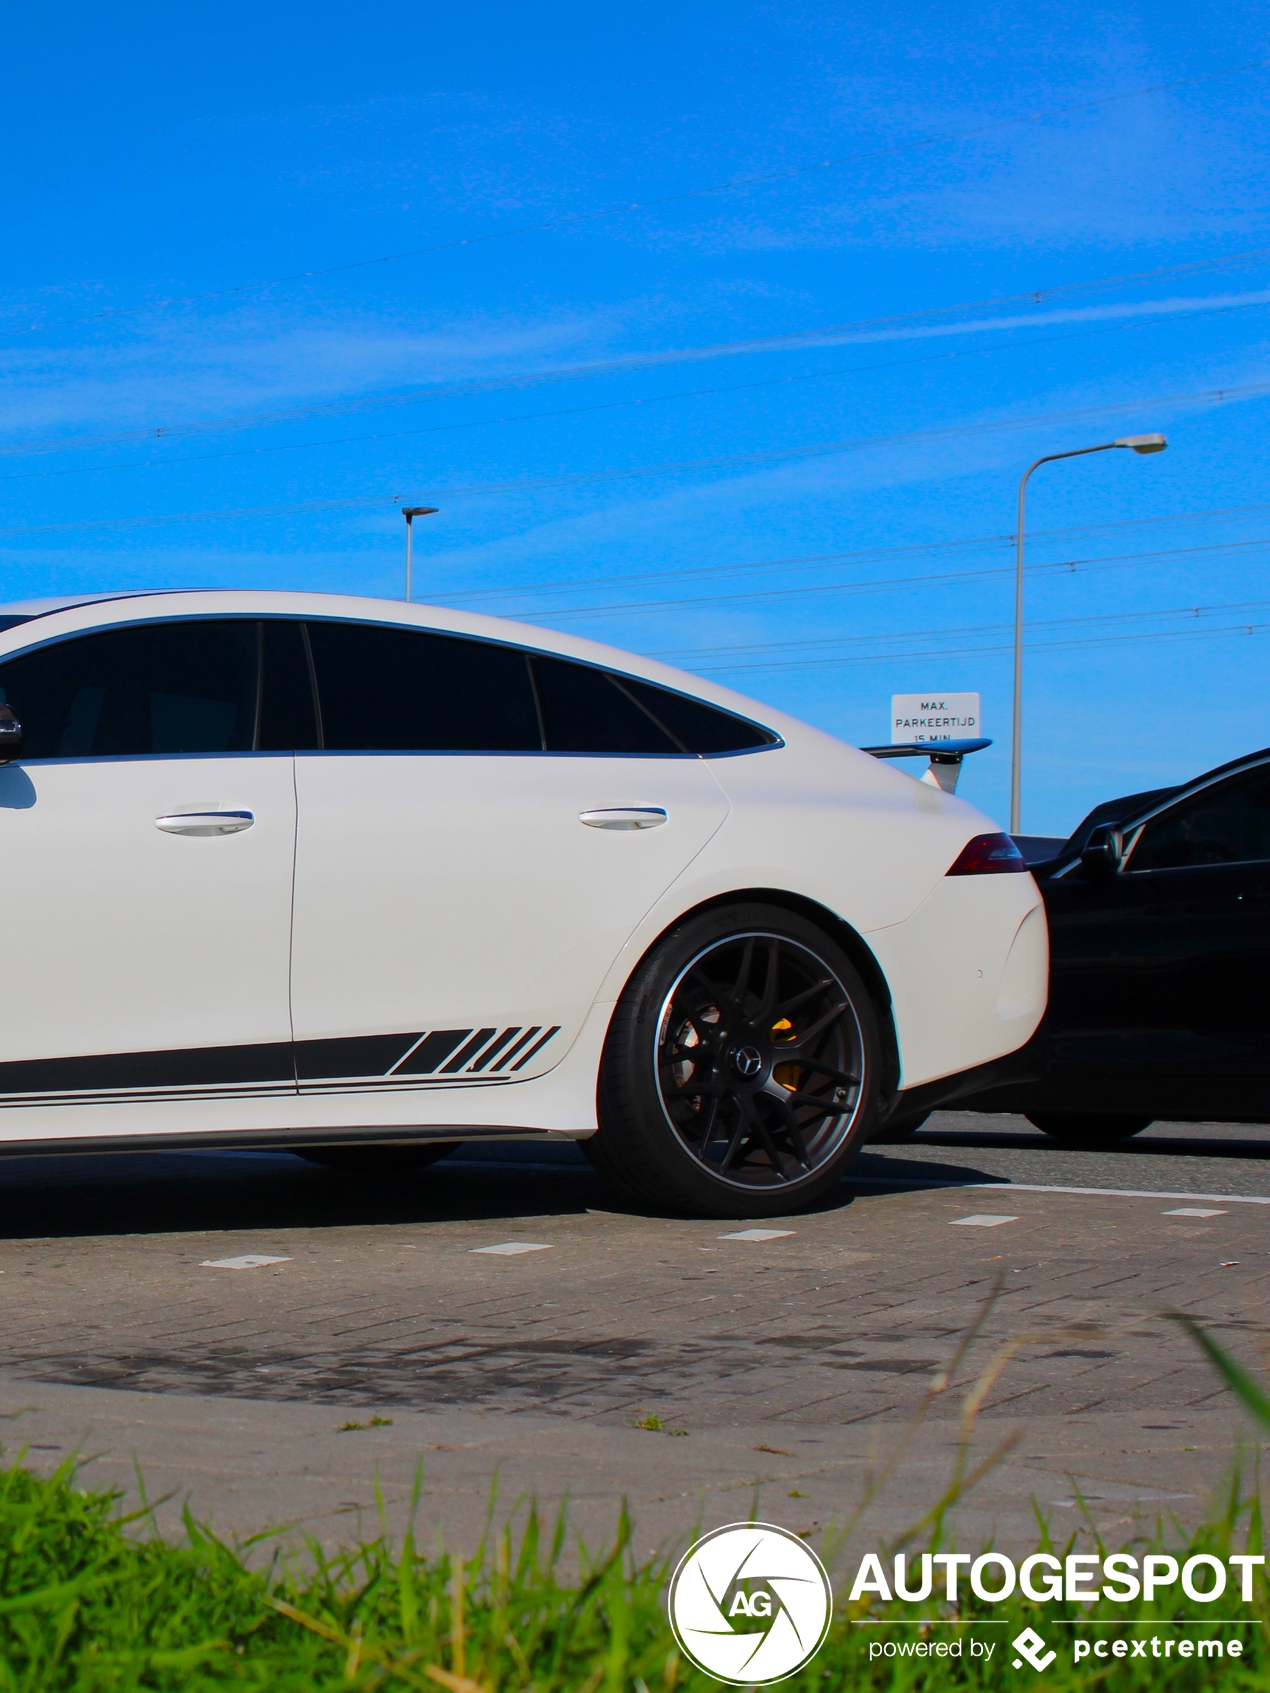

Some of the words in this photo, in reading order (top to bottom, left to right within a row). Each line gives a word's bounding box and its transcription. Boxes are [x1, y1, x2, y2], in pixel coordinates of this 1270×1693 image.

[920, 702, 948, 711] MAX.
[895, 717, 976, 728] PARKEERTIJD
[914, 734, 925, 742] 15
